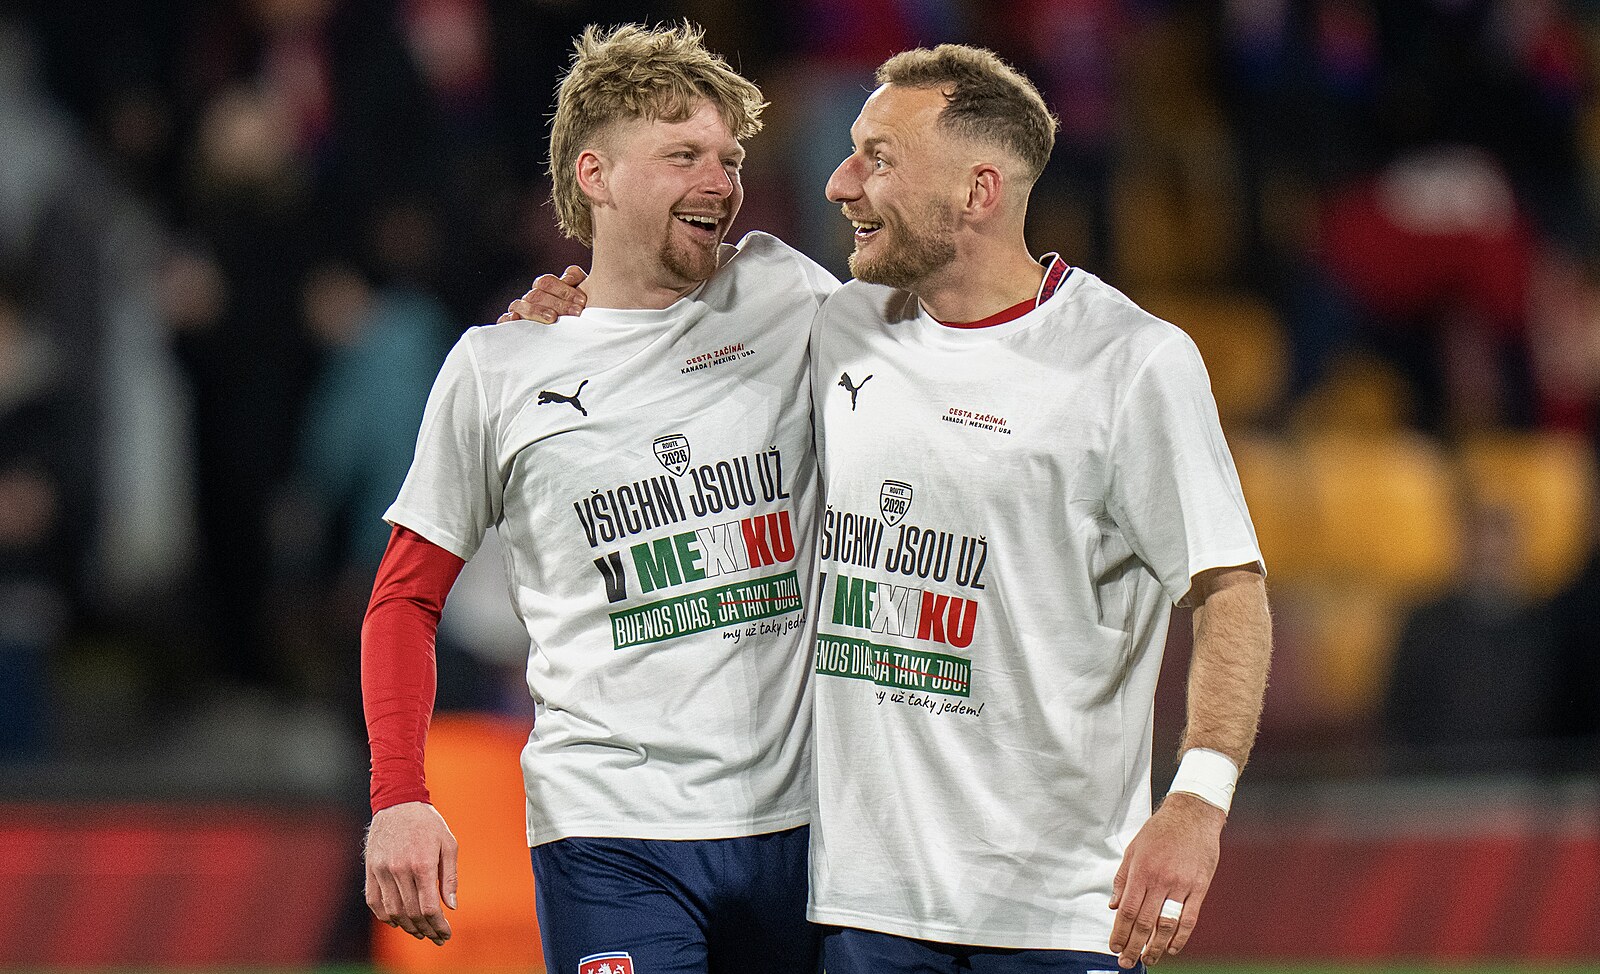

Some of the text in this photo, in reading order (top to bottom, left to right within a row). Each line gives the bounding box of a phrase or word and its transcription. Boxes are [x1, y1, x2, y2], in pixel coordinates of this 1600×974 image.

[681, 349, 756, 374] KANADA MEXIKO USA
[686, 353, 713, 365] CESTA
[942, 415, 1011, 435] KANADA MEXIKO USA
[949, 407, 1007, 426] CESTA ZAČÍNÁ!
[662, 440, 679, 449] ROUTE
[662, 449, 687, 466] 2026
[573, 445, 790, 548] VŠICHNI JSOU UŽ
[889, 486, 904, 496] ROUTE
[883, 497, 906, 515] 2026
[593, 511, 796, 603] V MEXIKU
[821, 504, 988, 590] ŠICHNI JSOU UŽ
[614, 607, 675, 647] BUENOS
[674, 597, 716, 633] DÍAS,
[718, 588, 739, 622] JÁ
[737, 582, 771, 619] TAKY
[772, 576, 800, 611] JDU!
[832, 574, 978, 649] MEXIKU
[723, 629, 741, 644] my
[745, 622, 757, 637] už
[760, 619, 782, 637] taky
[873, 648, 890, 682] JÁ
[893, 652, 931, 688] TAKY
[931, 659, 969, 693] JDU!
[876, 690, 985, 717] y už taky jedem!
